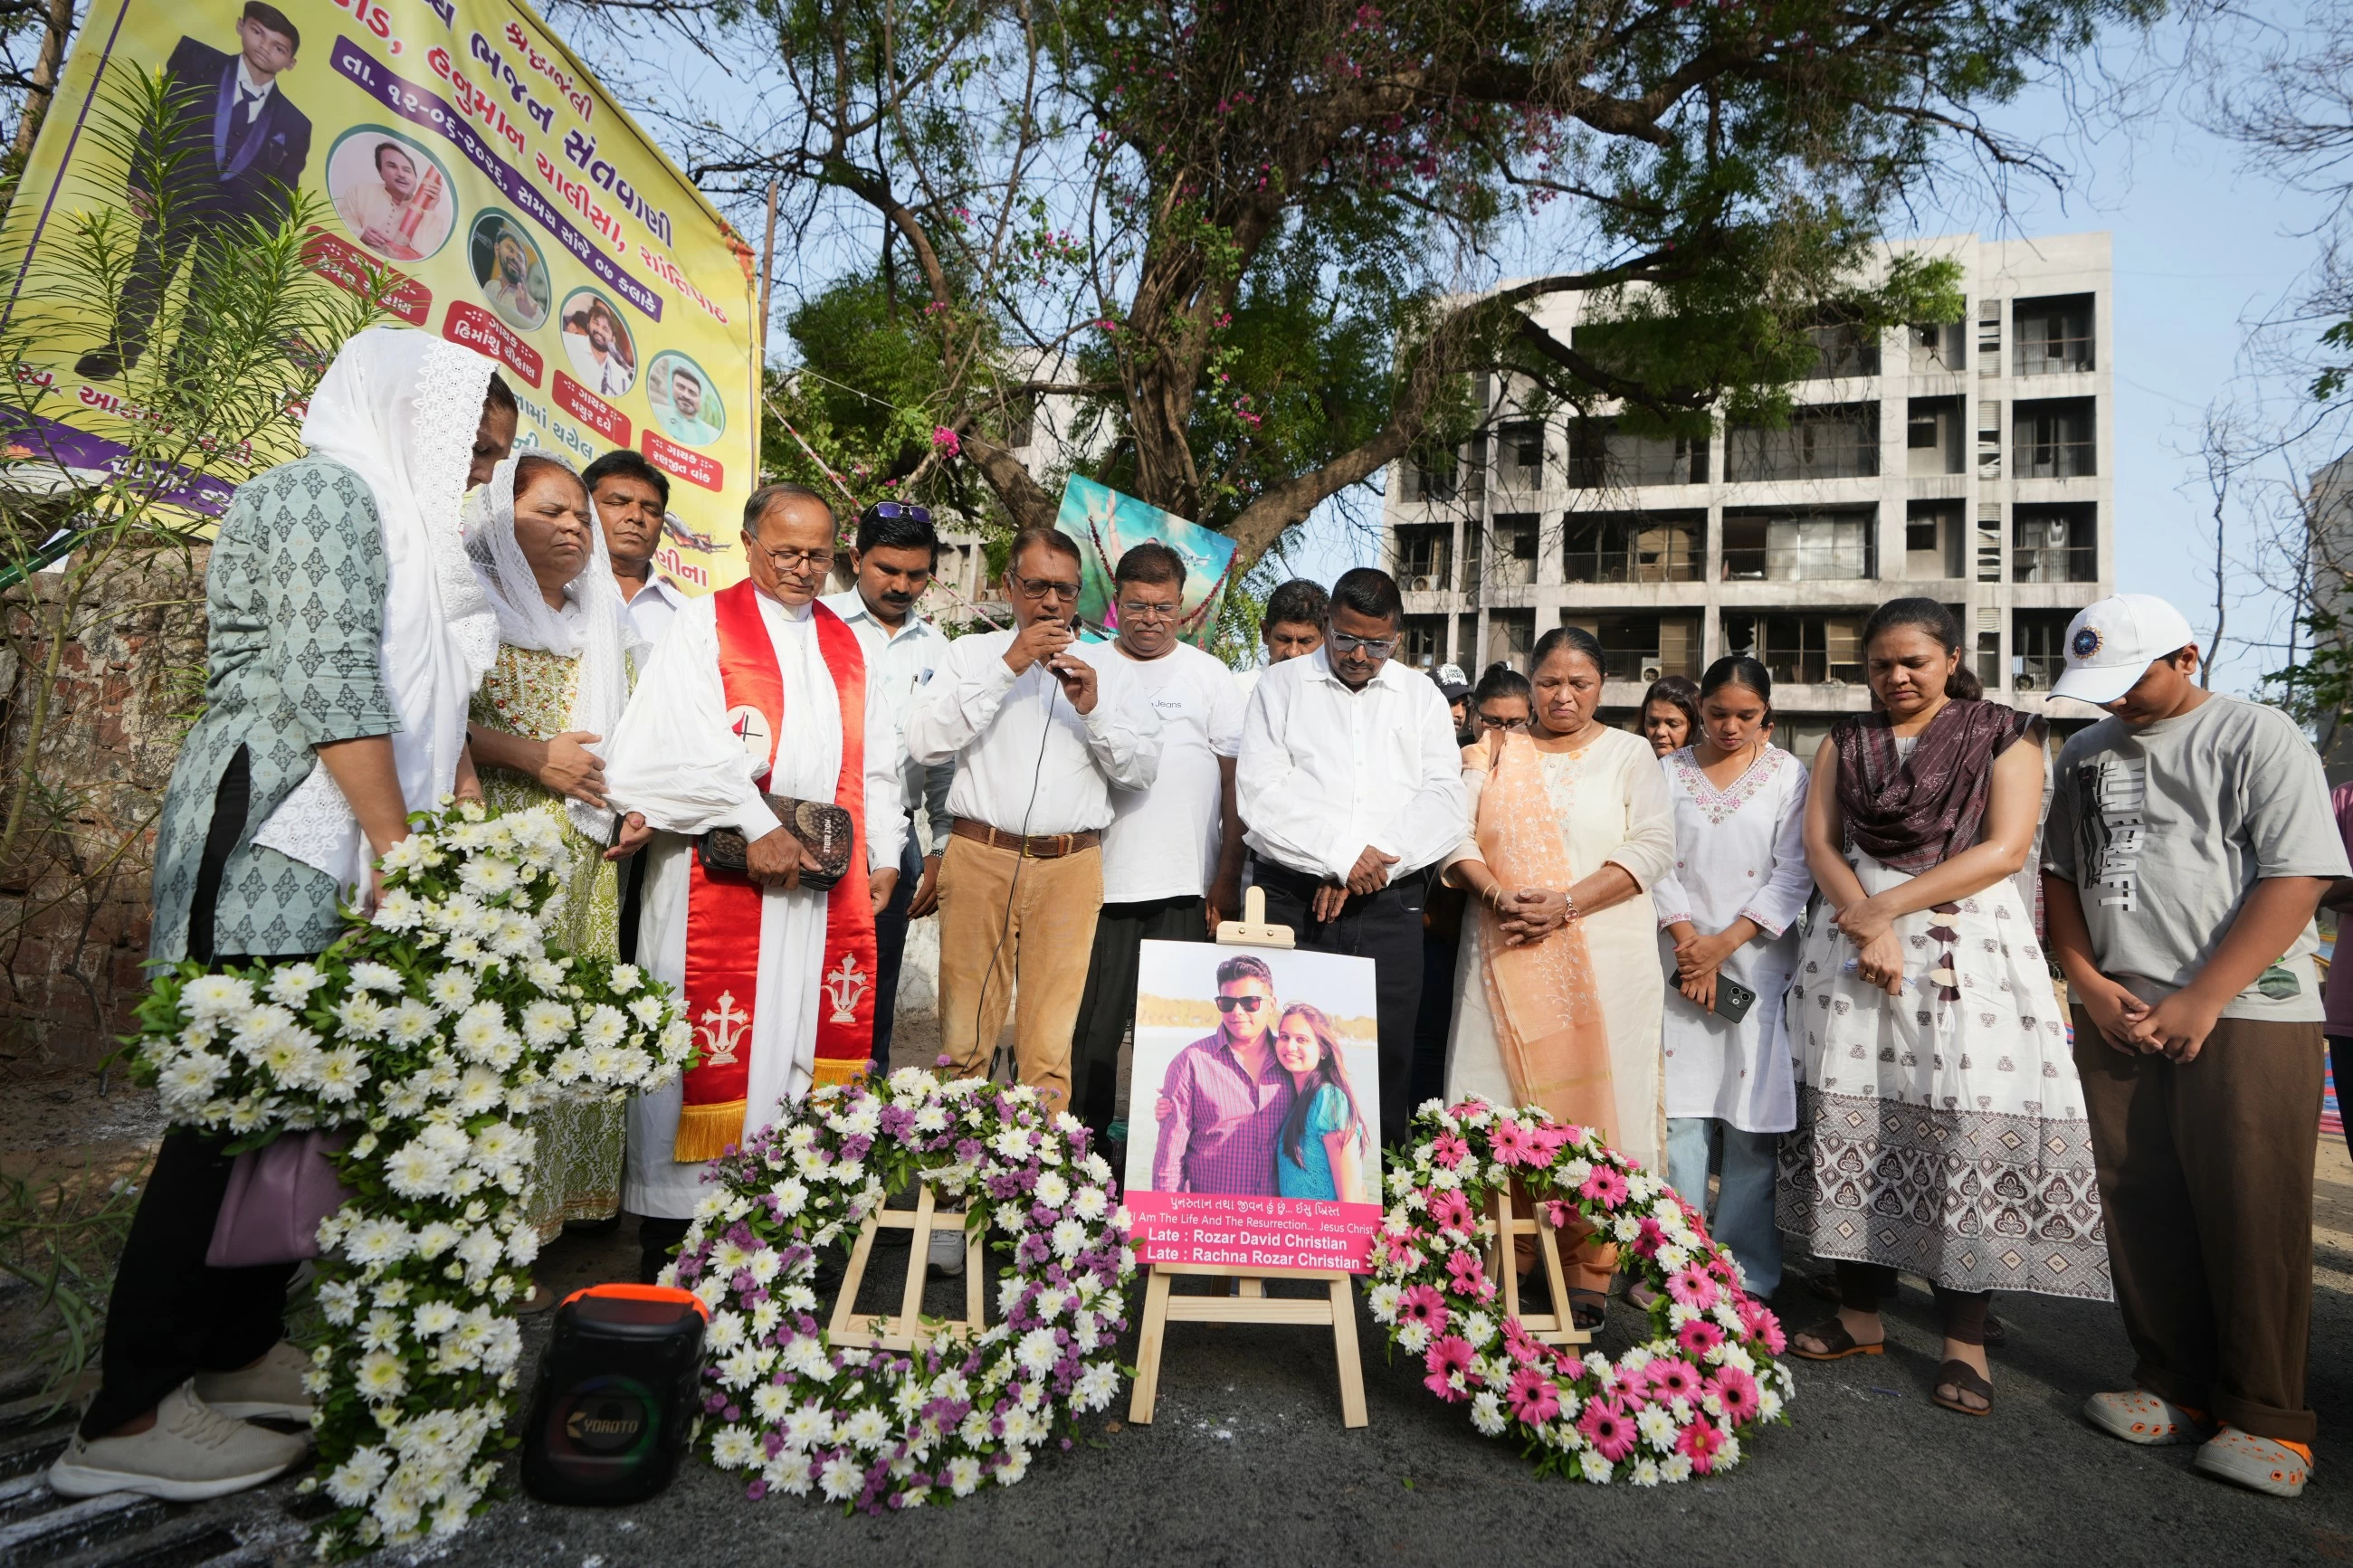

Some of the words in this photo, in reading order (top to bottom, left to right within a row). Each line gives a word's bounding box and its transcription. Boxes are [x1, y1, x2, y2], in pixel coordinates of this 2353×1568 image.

[471, 33, 554, 134] ભજન
[564, 129, 672, 249] સંતવાણી
[342, 54, 375, 87] તા.
[518, 185, 556, 227] સમય
[561, 225, 591, 260] સાંજે
[595, 258, 614, 280] ૦૭
[618, 277, 657, 313] કલાકે
[427, 47, 525, 155] હનુમાન
[536, 151, 625, 252] ચાલીસા,
[640, 245, 729, 324] શાંતિપાઠ
[488, 317, 519, 349] ગાયક
[454, 319, 500, 356] હિમાંશુ
[504, 345, 535, 379] ચૌહાણ
[570, 398, 595, 423] મયુર
[596, 417, 613, 433] દવે
[578, 389, 607, 415] ગાયક
[552, 422, 594, 461] થયેલ
[667, 441, 697, 465] ગાયક
[653, 451, 688, 473] રણજીત
[691, 466, 711, 484] વાંક
[1155, 699, 1182, 708] Jeans
[824, 818, 832, 834] HOLY
[2097, 755, 2146, 912] MINECRAFT
[823, 834, 832, 854] BIBLE
[1215, 1199, 1234, 1211] તથા
[1237, 1200, 1264, 1212] જીવન
[1295, 1202, 1312, 1217] ઈસુ
[1138, 1212, 1156, 1222] Am
[1159, 1212, 1178, 1223] The
[1181, 1213, 1199, 1224] Life
[1201, 1215, 1222, 1226] And
[1224, 1216, 1243, 1227] The
[1246, 1217, 1314, 1231] Resurrection...
[1319, 1221, 1345, 1233] Jesus
[1347, 1222, 1374, 1235] Christ
[1148, 1227, 1180, 1242] Late
[1193, 1229, 1235, 1245] Rozar
[1240, 1231, 1281, 1247] David
[1284, 1233, 1348, 1250] Christian
[1147, 1245, 1179, 1261] Late
[1192, 1247, 1248, 1264] Rachna
[1252, 1250, 1294, 1266] Rozar
[1298, 1252, 1360, 1270] Christian
